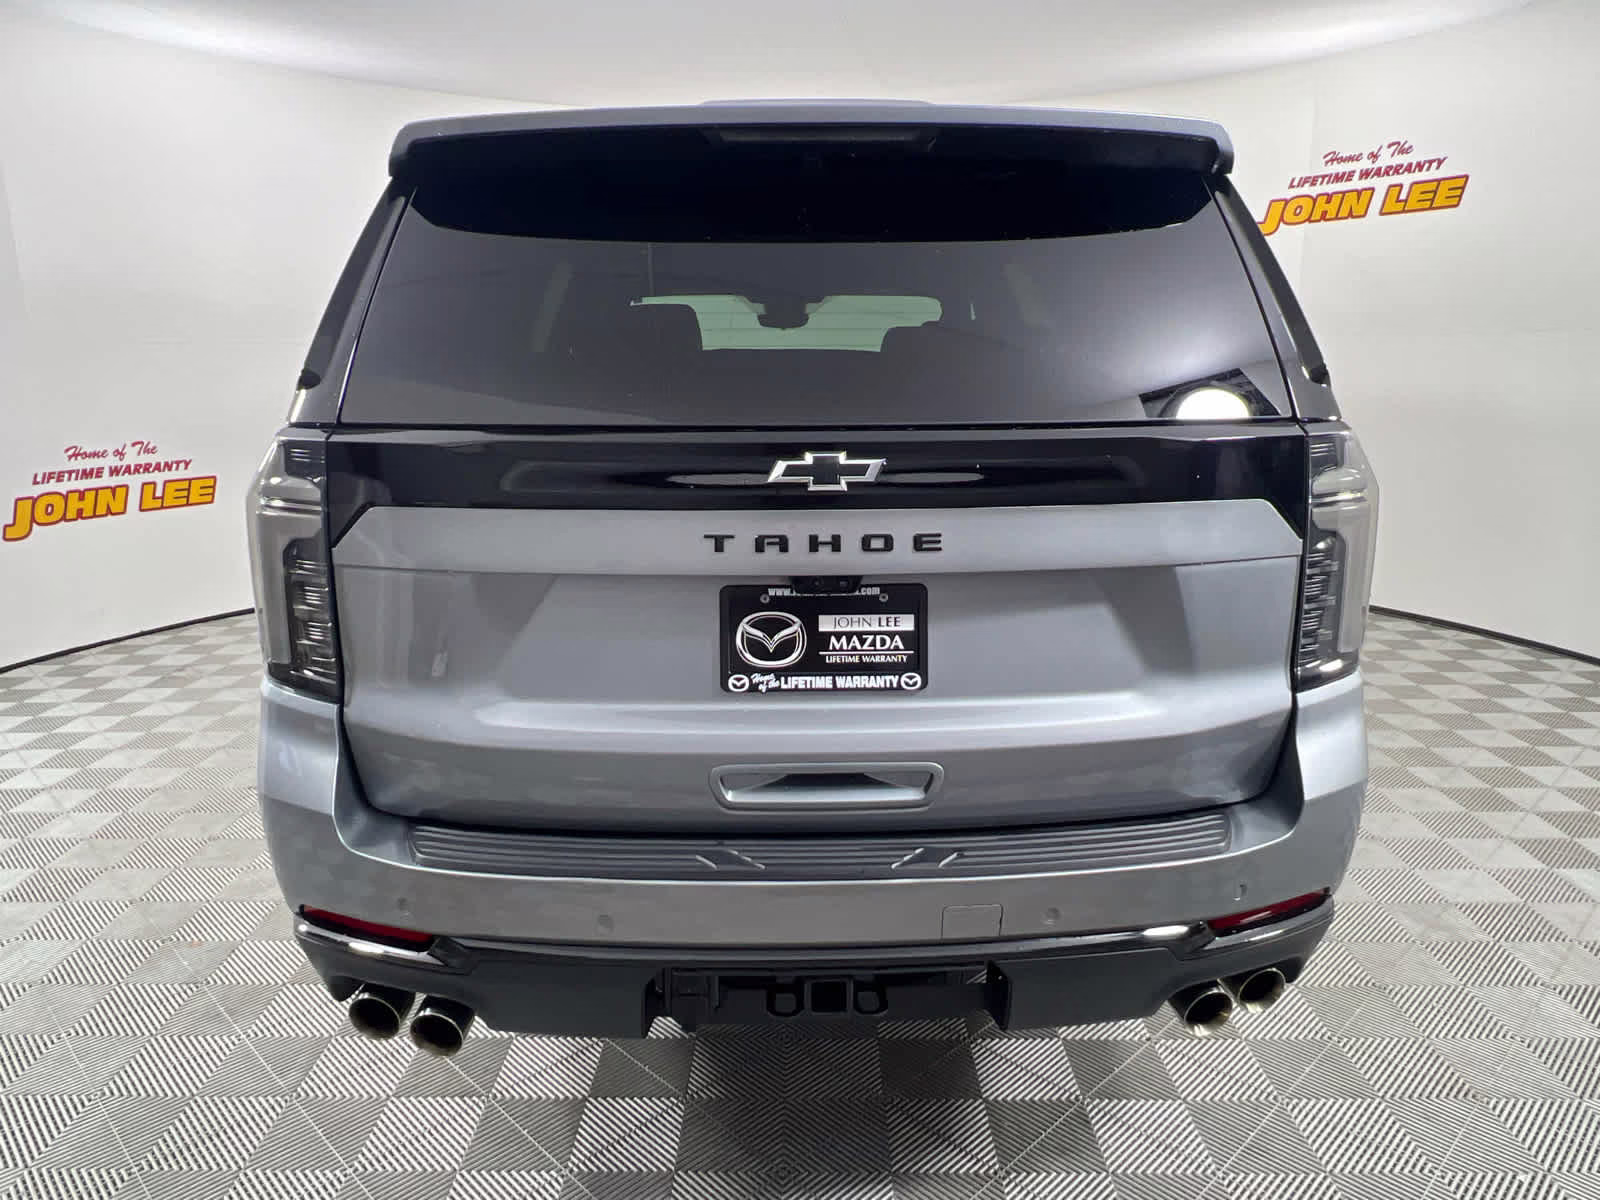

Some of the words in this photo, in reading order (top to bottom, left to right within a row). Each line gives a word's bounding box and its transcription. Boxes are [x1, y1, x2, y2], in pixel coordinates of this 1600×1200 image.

[1323, 150, 1363, 167] Home
[1367, 145, 1382, 163] of
[1387, 140, 1414, 158] The
[1288, 169, 1355, 190] LIFETIME
[1358, 156, 1448, 181] WARRANTY
[1257, 187, 1376, 236] JOHN
[1379, 174, 1469, 216] LEE
[64, 445, 109, 462] Home
[113, 443, 127, 461] of
[131, 440, 158, 456] The
[32, 466, 105, 485] LIFETIME
[108, 459, 192, 477] WARRANTY
[2, 484, 129, 542] JOHN
[139, 475, 217, 512] LEE
[703, 532, 943, 553] TAHOE
[833, 616, 872, 628] JOHN
[877, 616, 901, 627] LEE
[829, 634, 904, 650] MAZDA
[825, 655, 860, 663] LIFETIME
[862, 655, 908, 663] WARRANTY
[751, 673, 775, 684] Home
[780, 676, 833, 689] LIFETIME
[835, 675, 899, 689] WARRANTY
